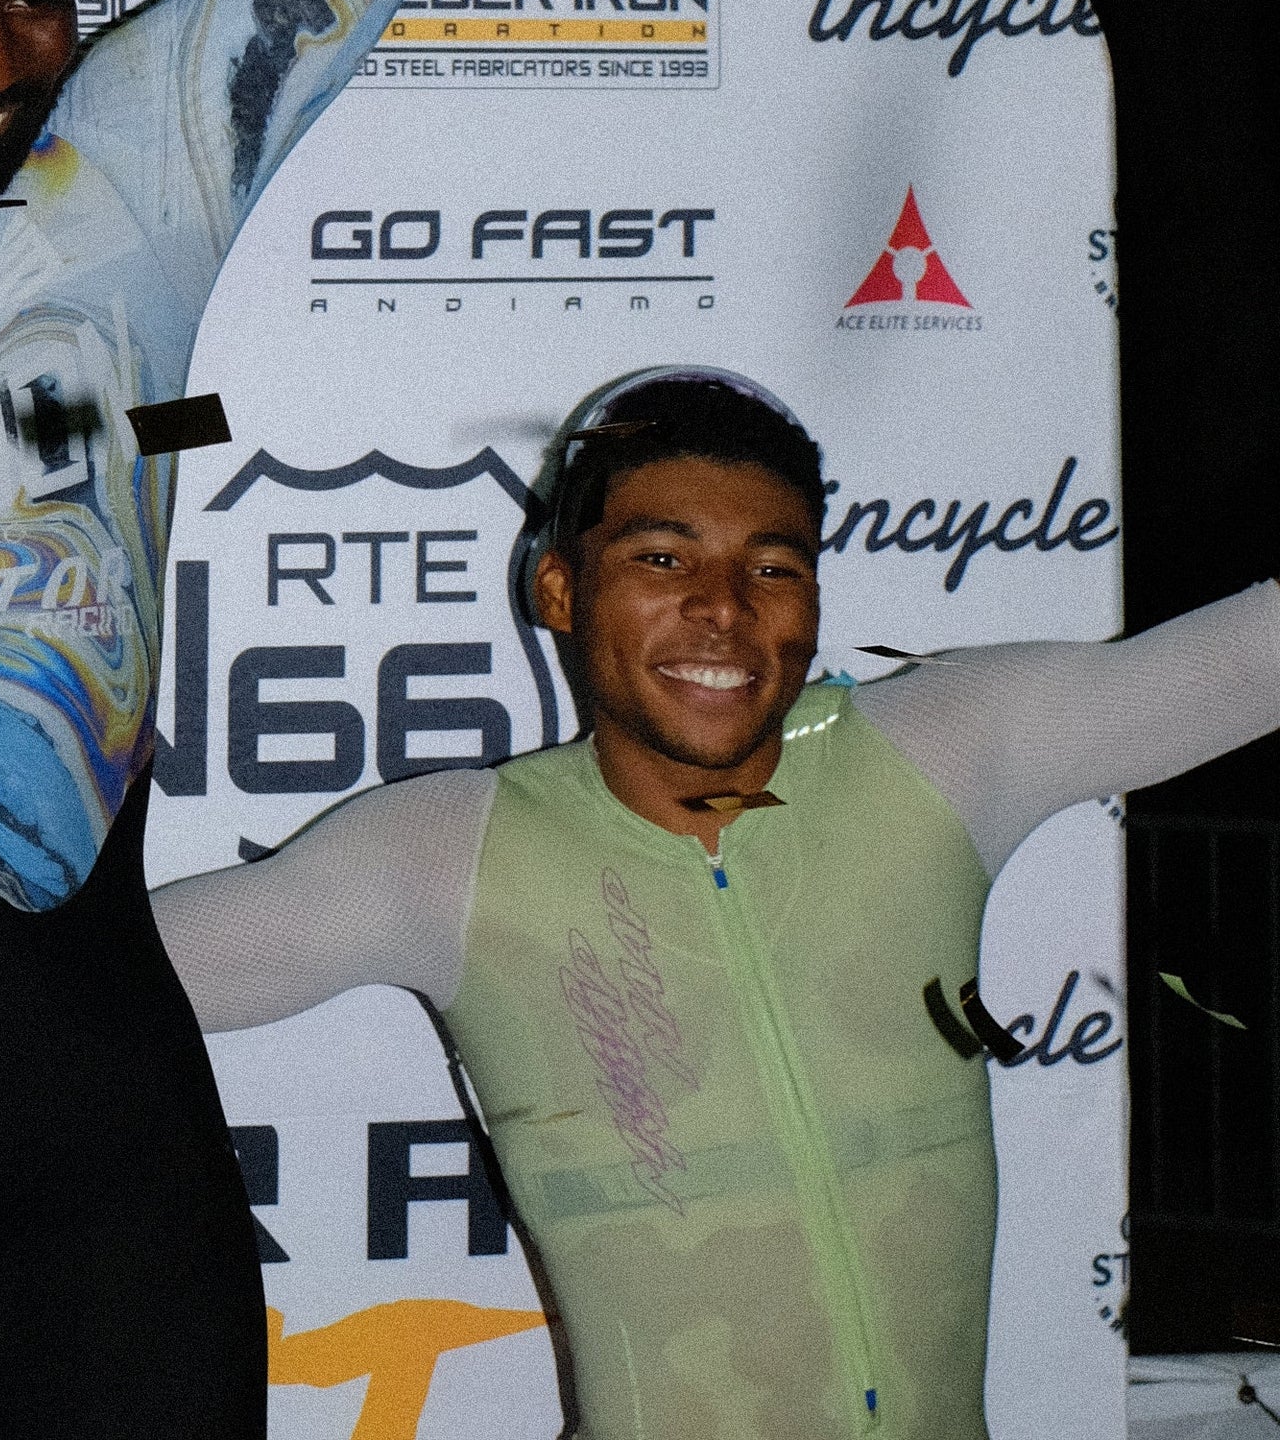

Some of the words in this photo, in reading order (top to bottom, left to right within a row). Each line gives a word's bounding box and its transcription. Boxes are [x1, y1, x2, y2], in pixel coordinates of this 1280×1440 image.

[392, 22, 706, 38] ORATION
[385, 59, 444, 77] STEEL
[452, 59, 592, 78] FABRICATORS
[598, 60, 655, 78] SINCE
[660, 60, 709, 78] 1993
[310, 209, 441, 261] GO
[471, 207, 716, 260] FAST
[310, 294, 716, 314] ANDIAMO
[835, 315, 864, 331] ACE
[868, 315, 909, 331] ELITE
[913, 315, 983, 332] SERVICES
[817, 455, 1121, 592] incycle
[267, 529, 479, 606] RTE
[227, 642, 512, 795] 66
